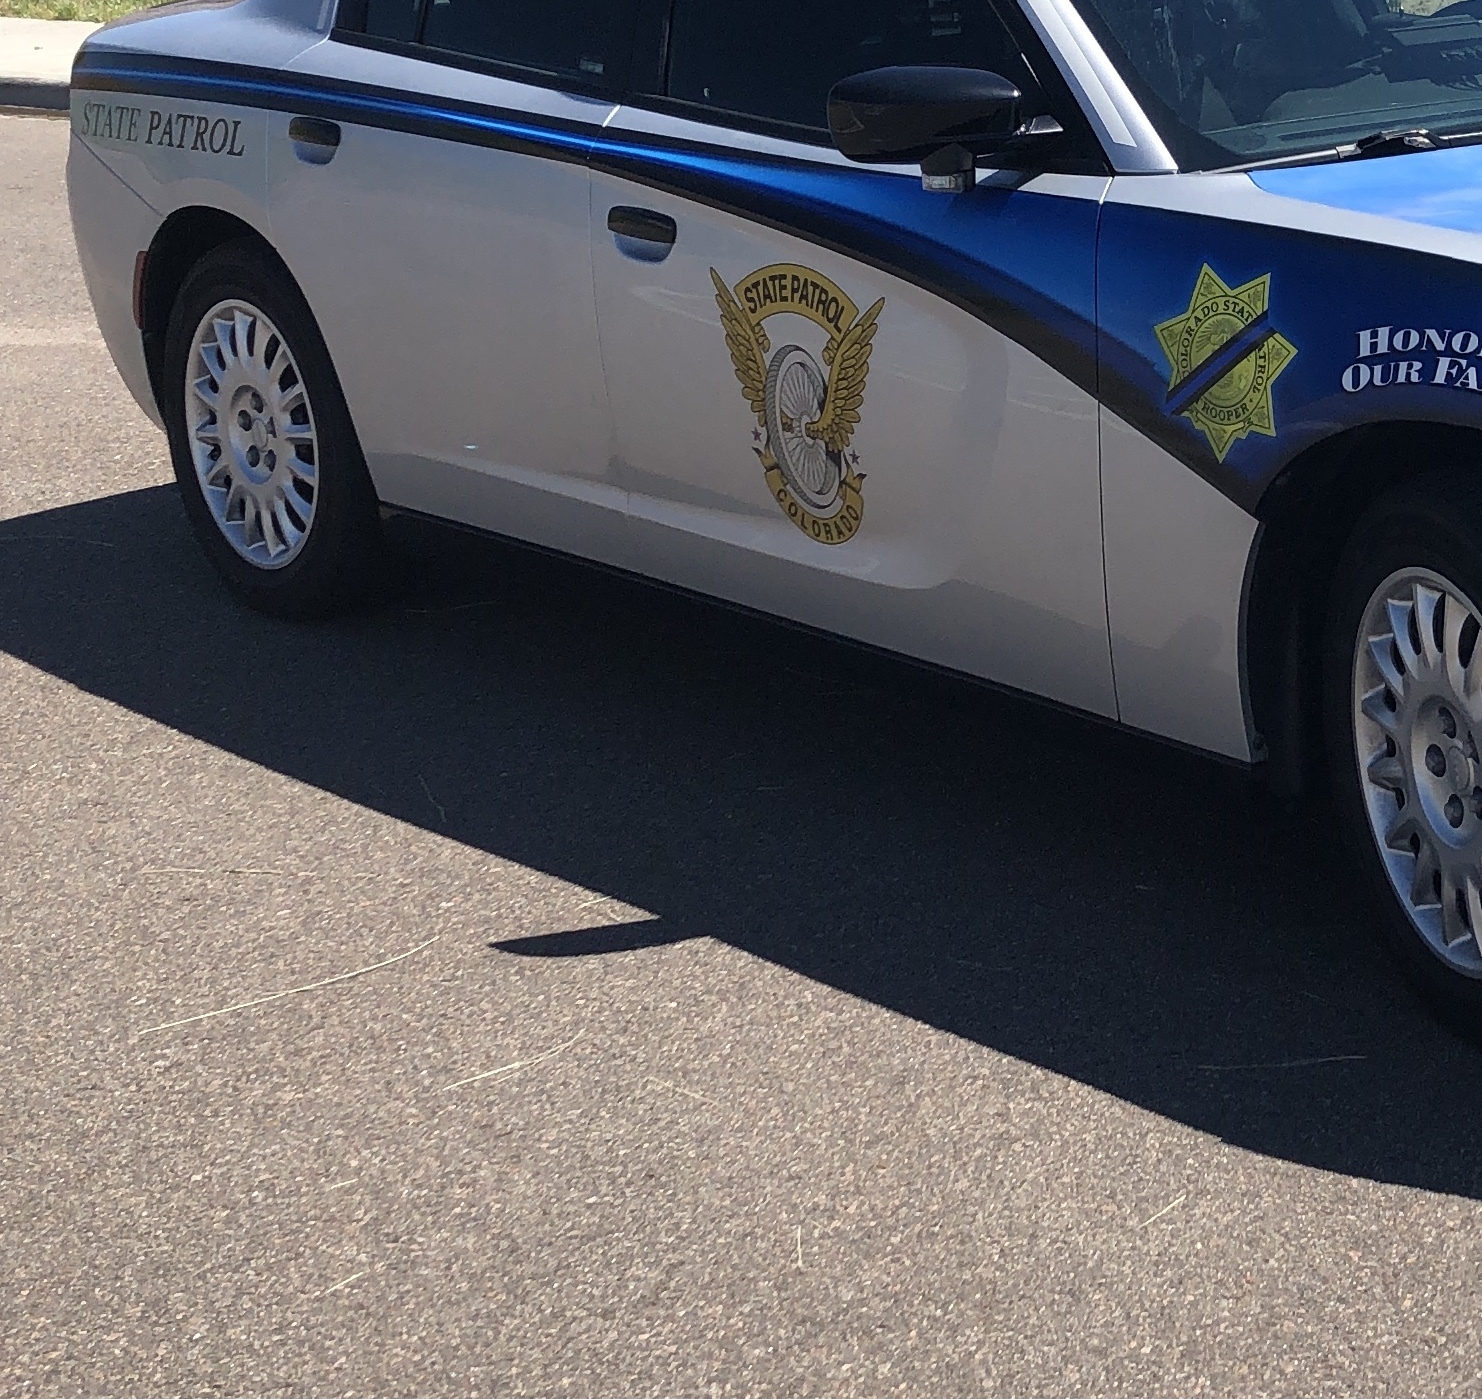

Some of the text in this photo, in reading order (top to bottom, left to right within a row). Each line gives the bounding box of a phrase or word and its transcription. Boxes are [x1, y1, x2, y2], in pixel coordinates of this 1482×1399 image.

[82, 101, 245, 157] STATE PATROL
[743, 273, 845, 334] STATE PATROL
[1222, 300, 1254, 323] STAT
[1253, 343, 1267, 395] TROL
[1341, 360, 1423, 393] OUR
[1200, 402, 1250, 422] ROOPER
[777, 487, 860, 542] COLORADO
